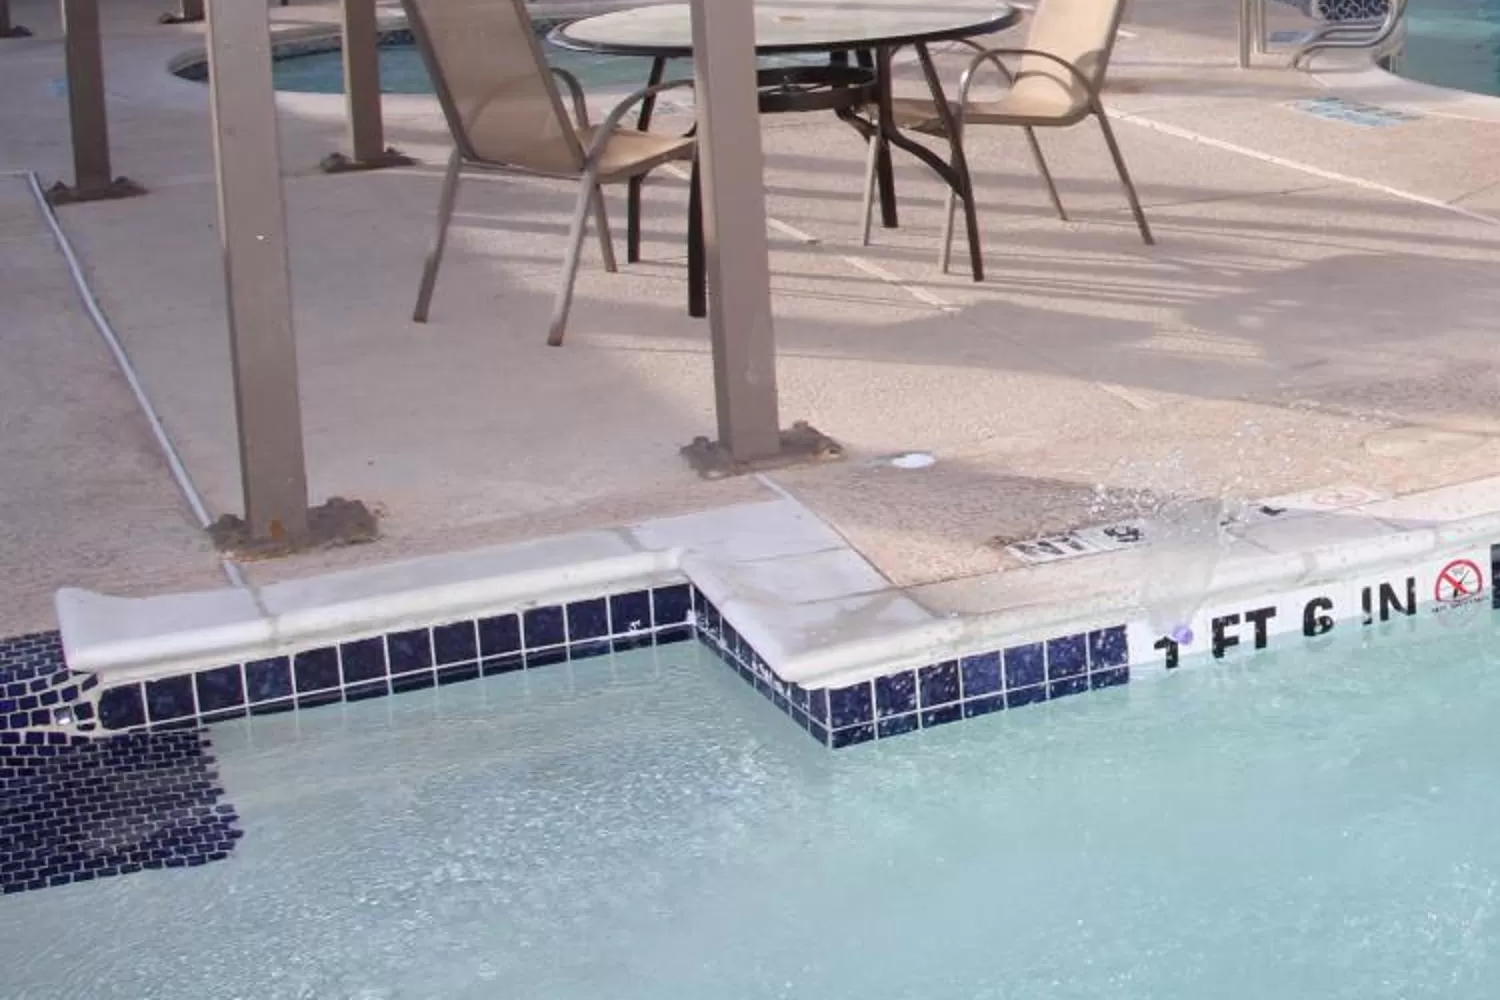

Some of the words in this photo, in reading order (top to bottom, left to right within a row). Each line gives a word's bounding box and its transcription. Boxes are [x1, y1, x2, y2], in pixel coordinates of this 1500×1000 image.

[1211, 606, 1277, 659] FT
[1303, 597, 1334, 636] 6
[1361, 576, 1417, 625] IN
